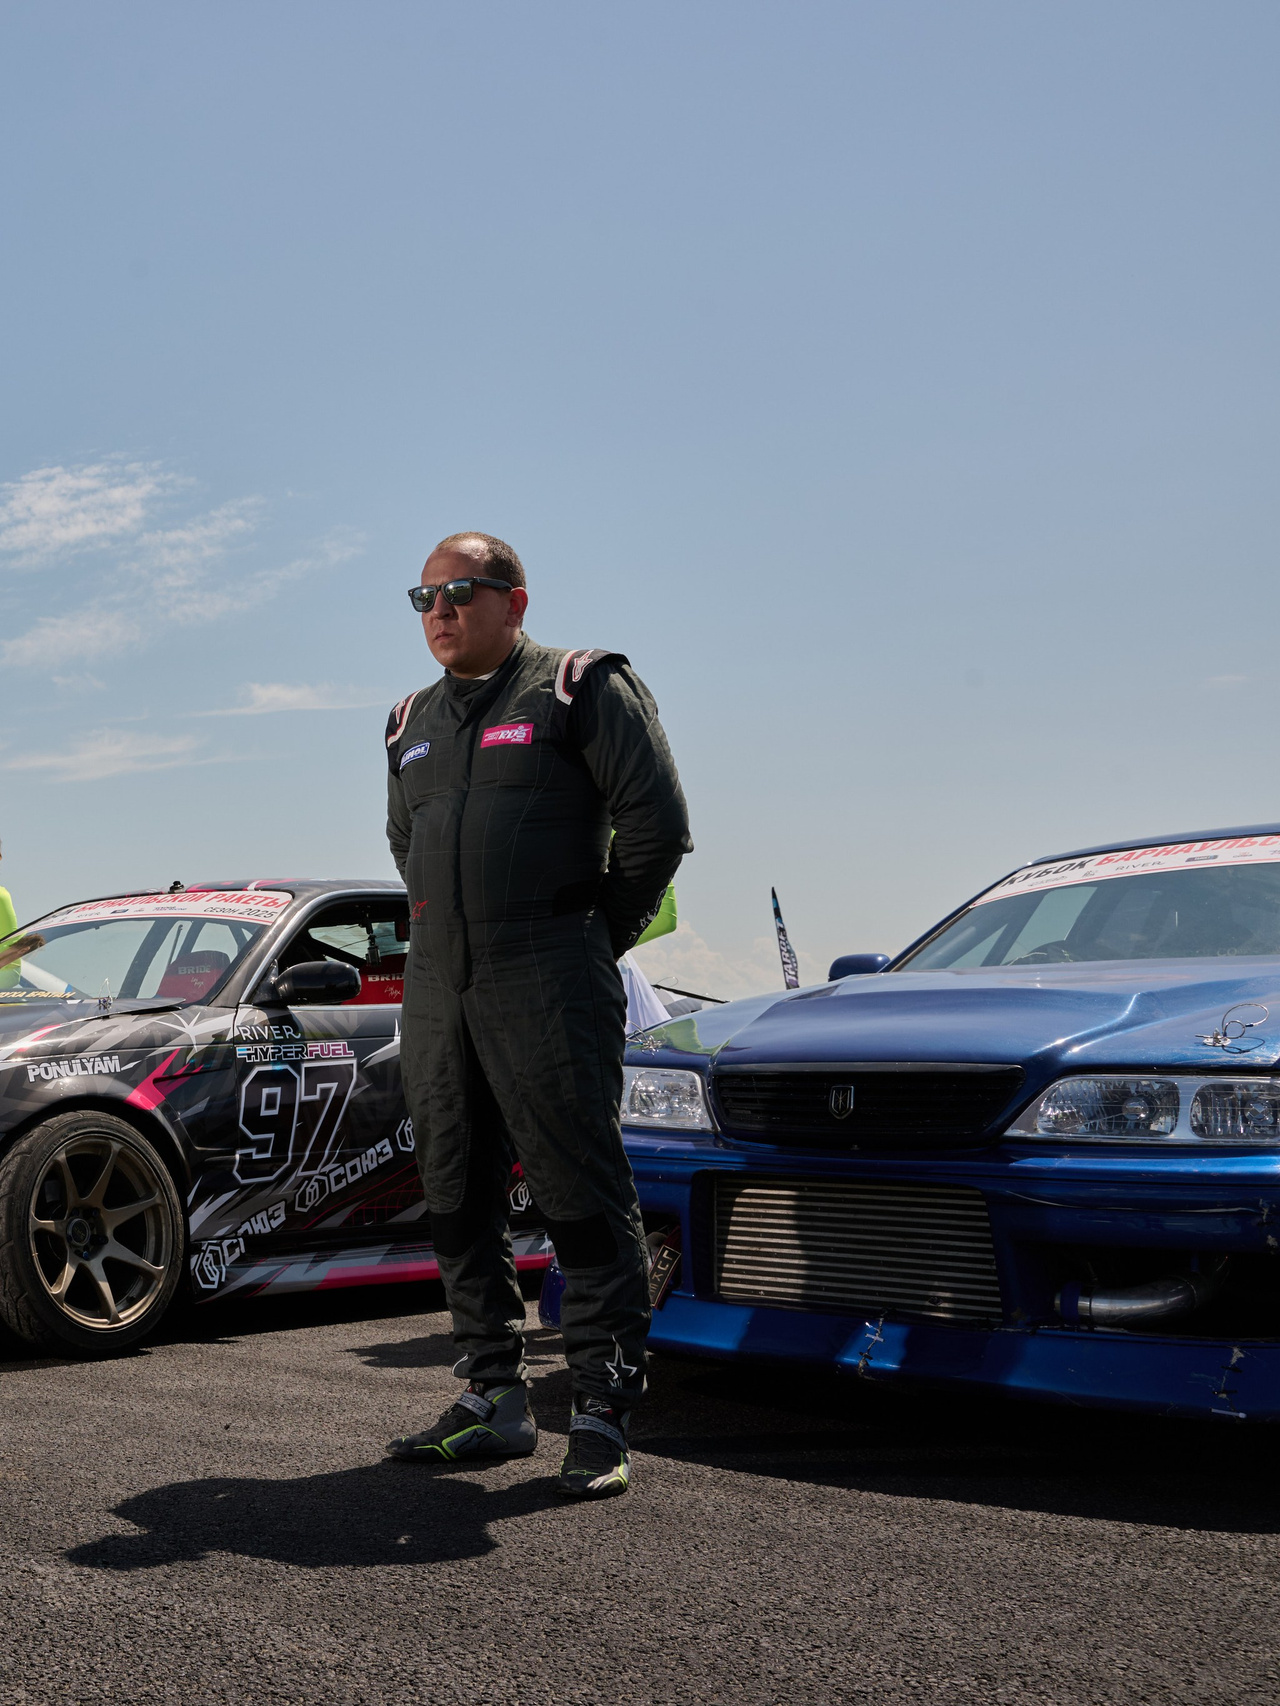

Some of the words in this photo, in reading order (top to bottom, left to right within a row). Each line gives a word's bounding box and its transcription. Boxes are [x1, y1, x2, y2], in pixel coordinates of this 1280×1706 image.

[1001, 858, 1095, 888] КУБОК
[1115, 860, 1165, 871] RIVER
[206, 892, 291, 909] РАКЕТЫ
[204, 906, 237, 915] СЕЗОН
[237, 907, 279, 919] 2025
[178, 965, 211, 975] BRIDE
[237, 1024, 301, 1041] RIVER
[26, 1055, 121, 1083] PONULYAM
[233, 1059, 358, 1184] 97
[330, 1138, 394, 1193] СОЮЗ
